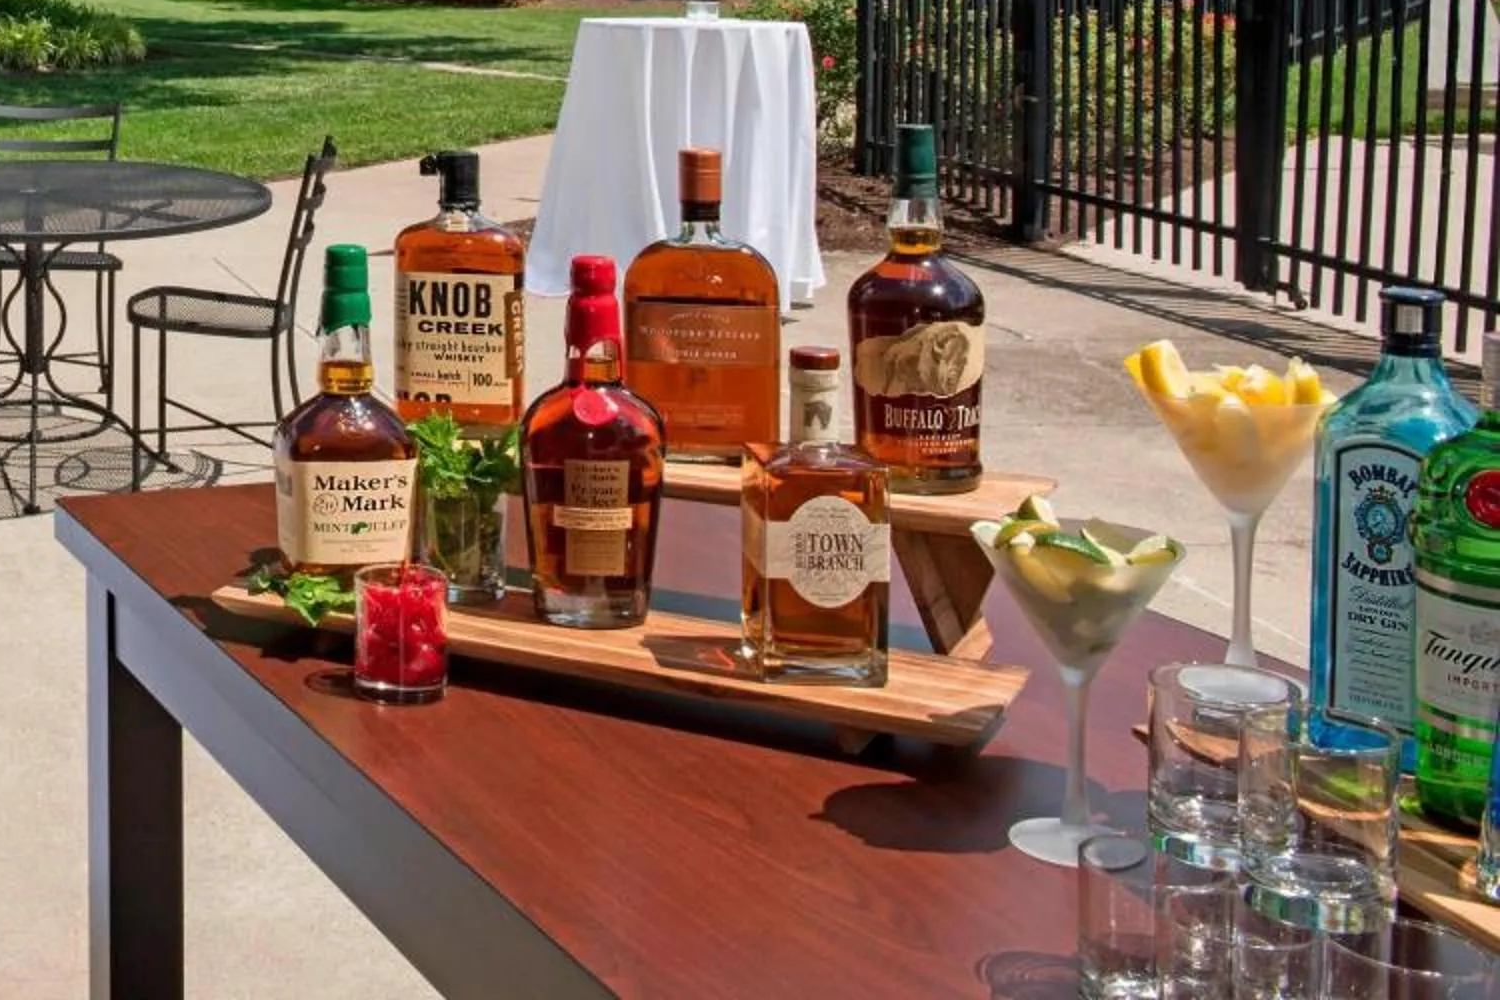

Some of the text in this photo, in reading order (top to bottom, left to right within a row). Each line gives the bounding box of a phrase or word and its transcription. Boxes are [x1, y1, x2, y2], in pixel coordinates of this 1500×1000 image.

[408, 279, 492, 318] KNOB
[417, 320, 504, 336] CREEK
[415, 340, 459, 353] straight
[434, 352, 485, 363] WHISKEY
[472, 373, 493, 387] 100
[884, 404, 943, 430] BUFFALO
[313, 474, 408, 491] Maker's
[1347, 464, 1417, 499] BOMBAY
[341, 494, 406, 512] Mark
[313, 522, 350, 534] MINT
[807, 532, 864, 554] TOWN
[807, 554, 866, 572] BRANCH
[1347, 611, 1410, 632] DRY GIN
